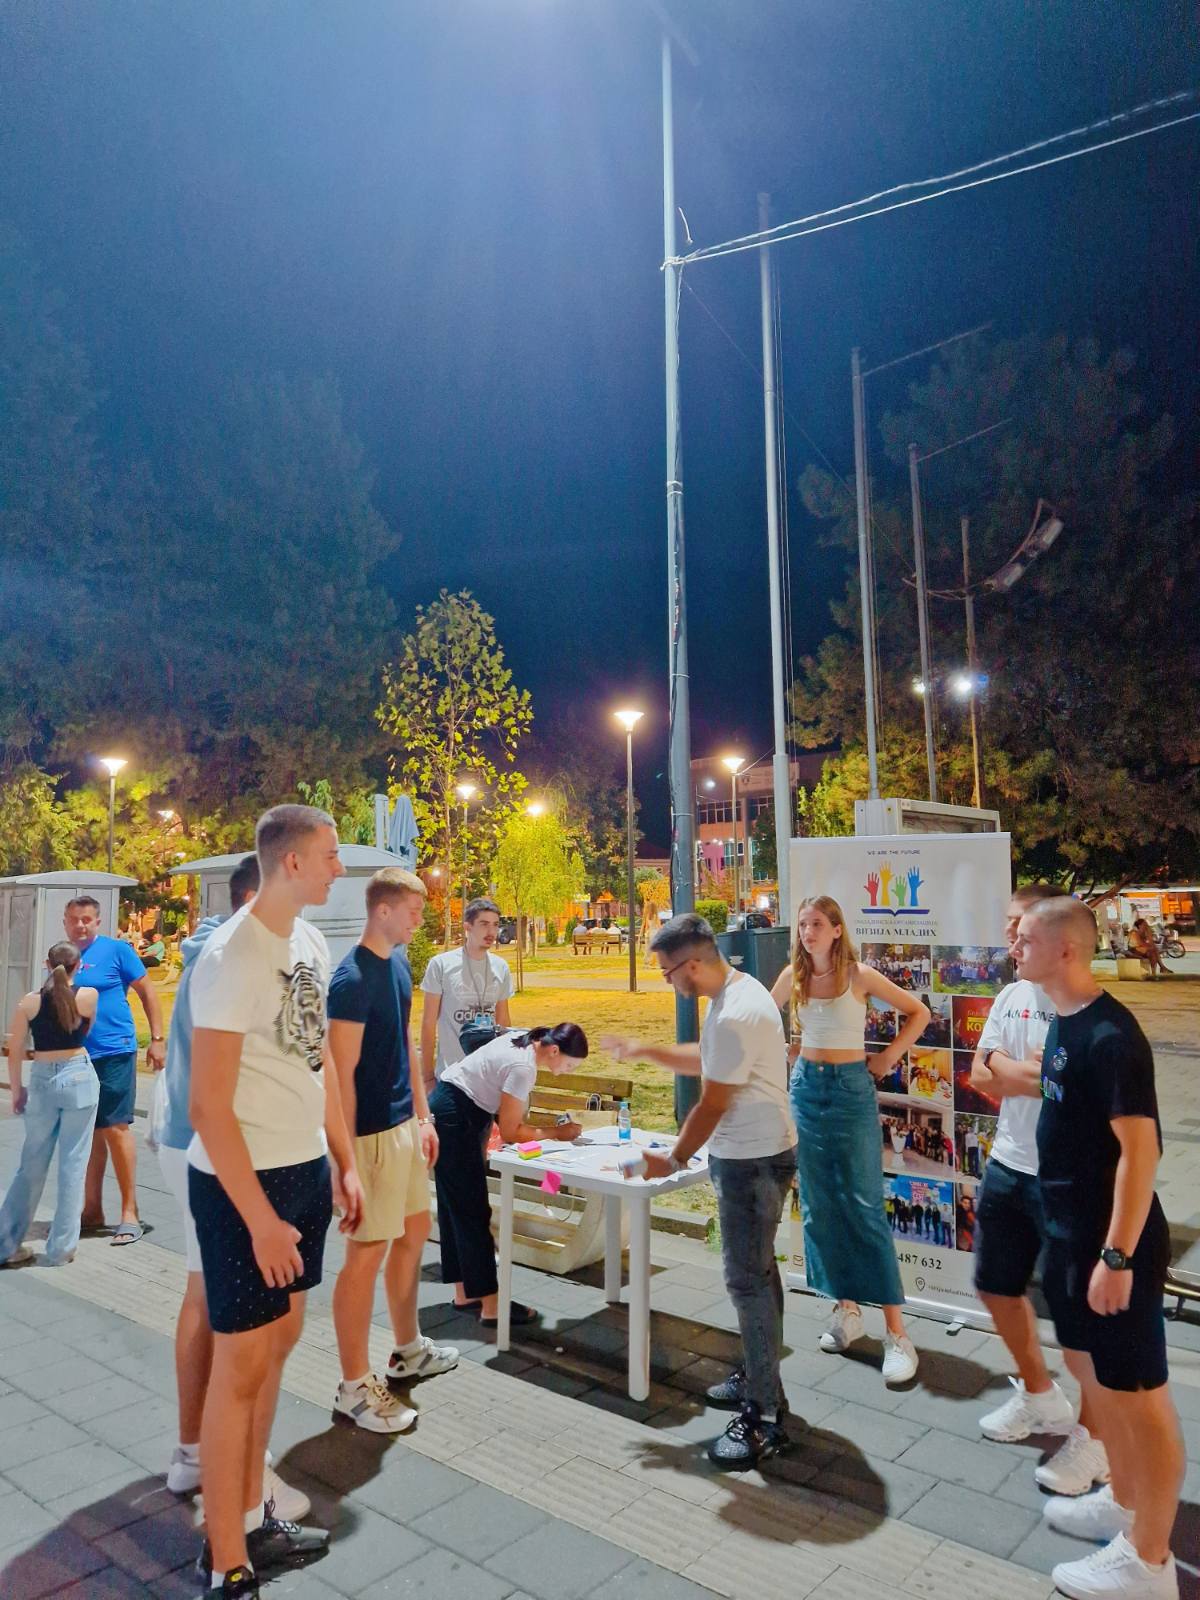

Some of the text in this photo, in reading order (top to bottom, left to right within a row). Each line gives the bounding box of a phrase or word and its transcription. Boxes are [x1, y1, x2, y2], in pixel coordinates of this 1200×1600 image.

[894, 928, 937, 937] МЛАДИХ
[897, 1252, 942, 1270] 487 632
